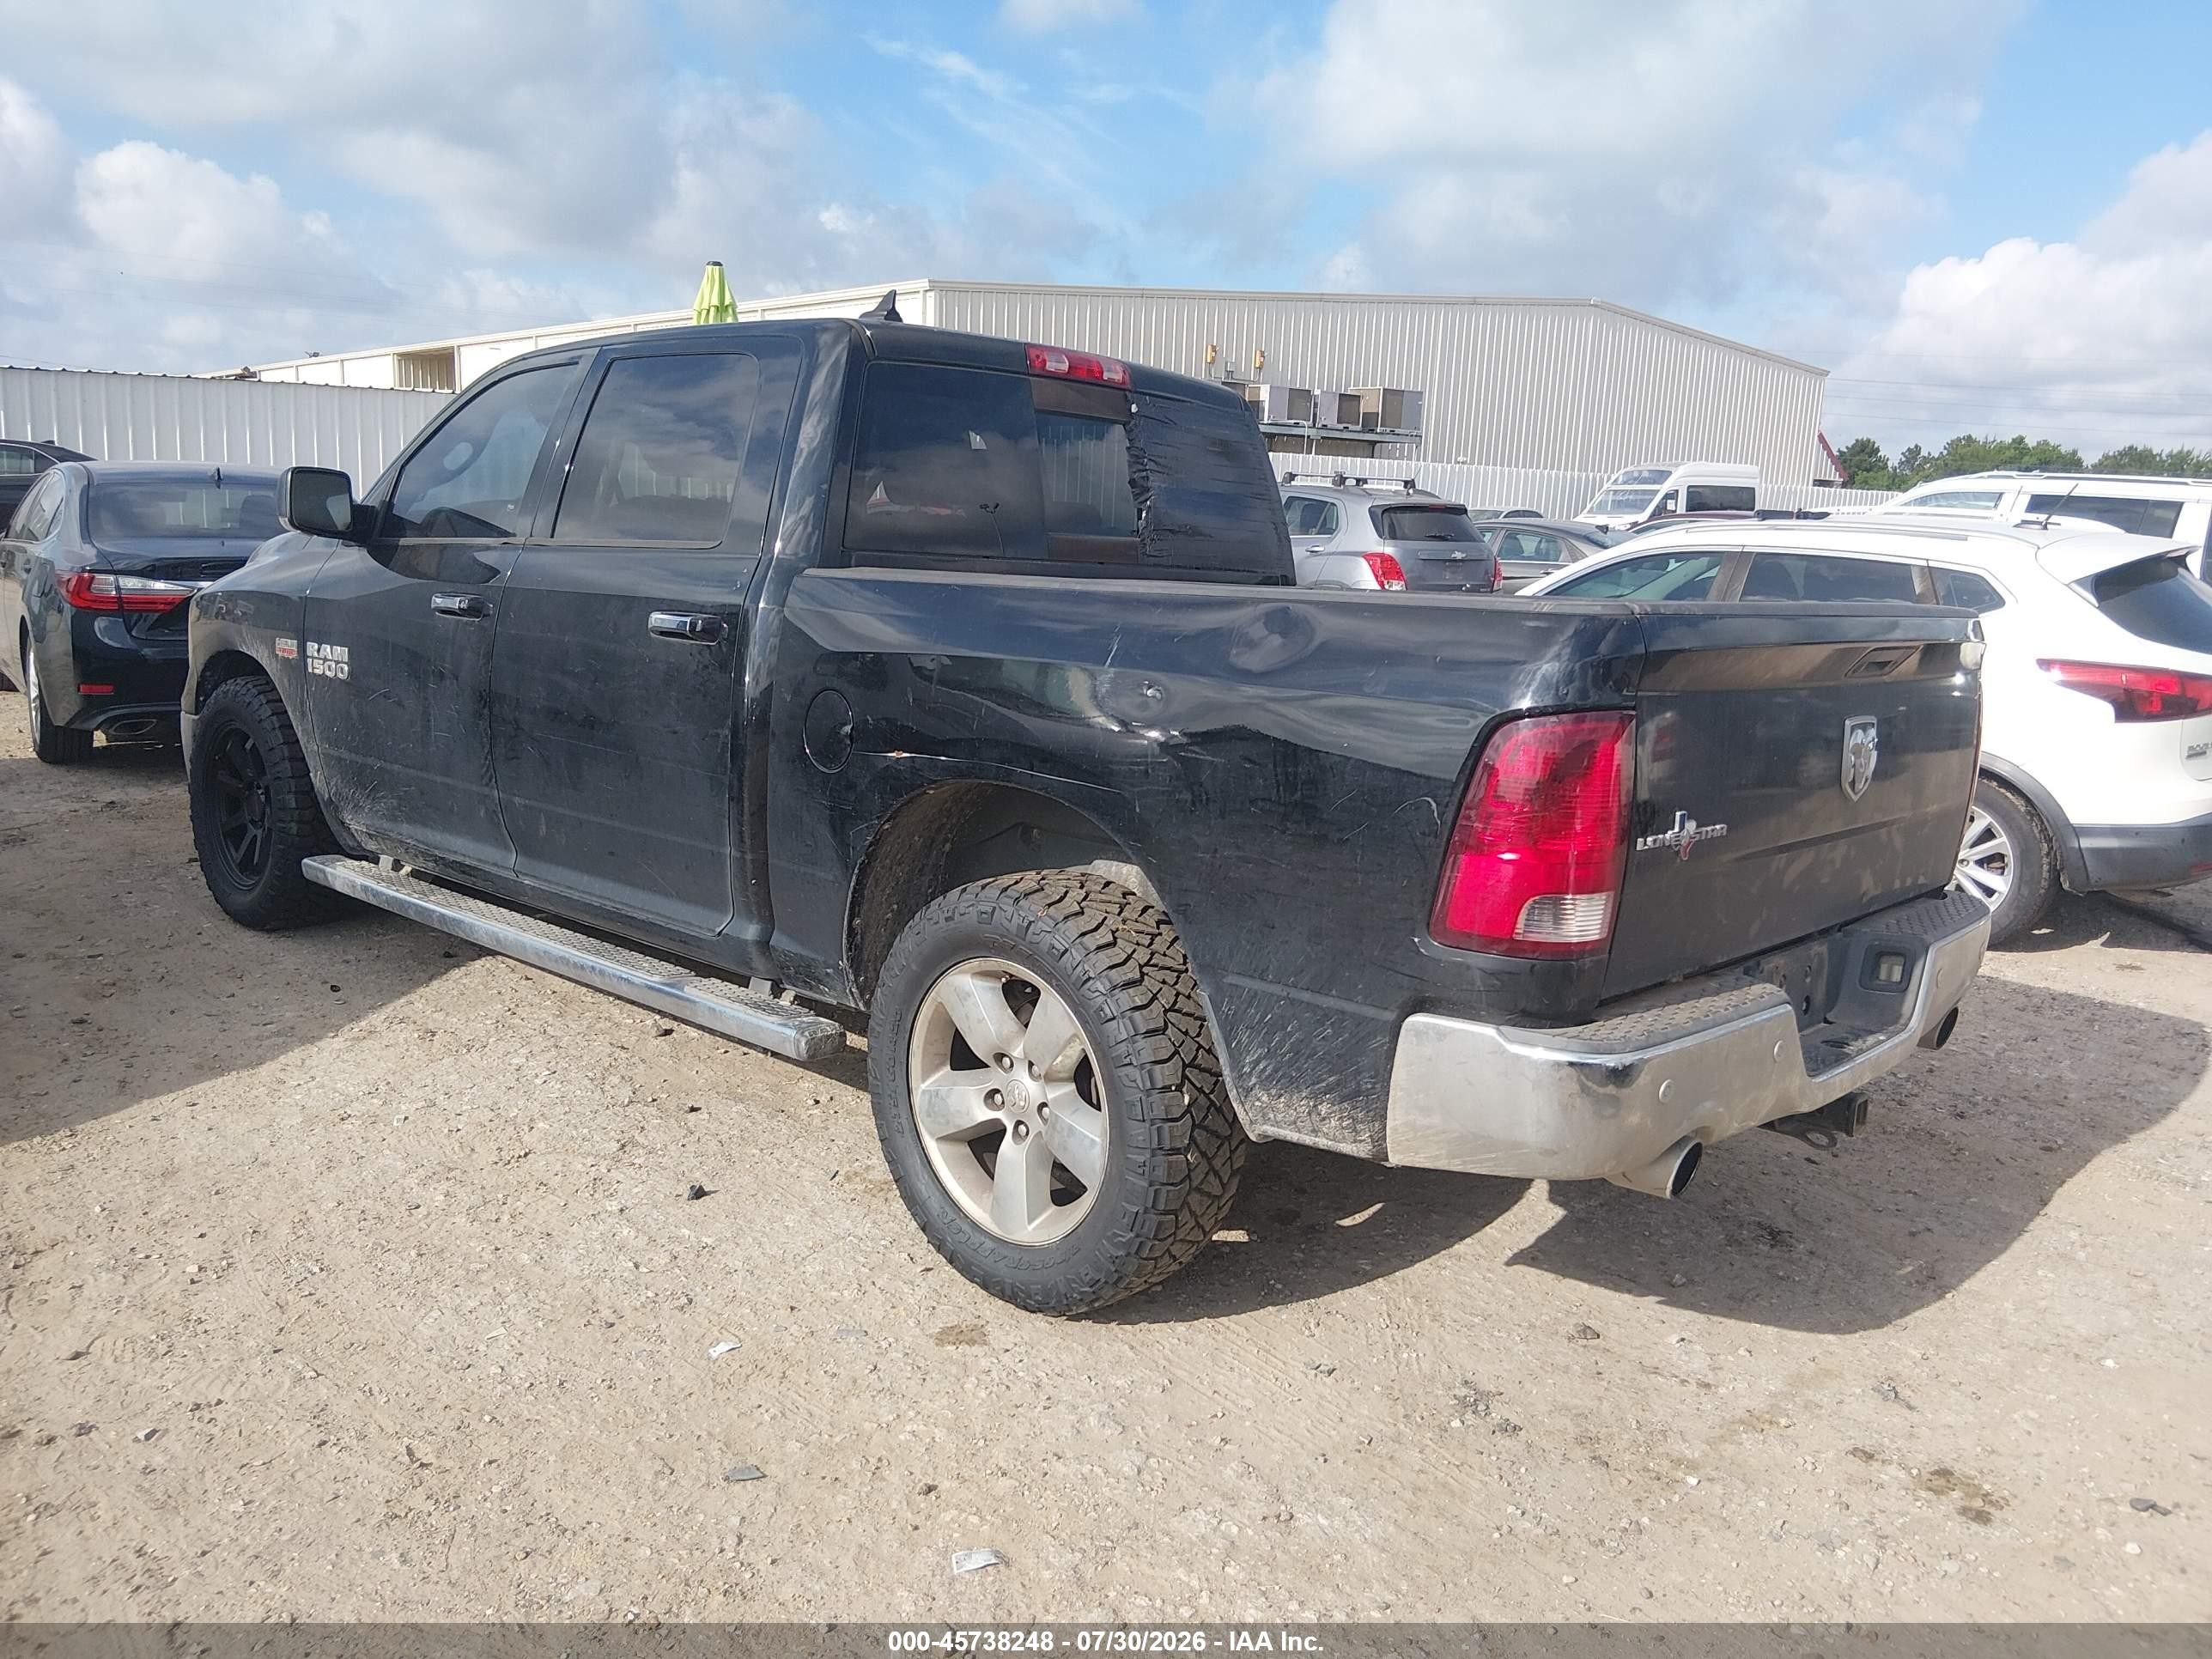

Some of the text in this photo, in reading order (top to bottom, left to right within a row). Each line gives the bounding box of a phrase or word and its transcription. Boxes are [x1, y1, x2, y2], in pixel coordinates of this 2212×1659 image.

[307, 641, 349, 663] RAM
[307, 658, 349, 679] 1500
[1692, 824, 1728, 842] STAR
